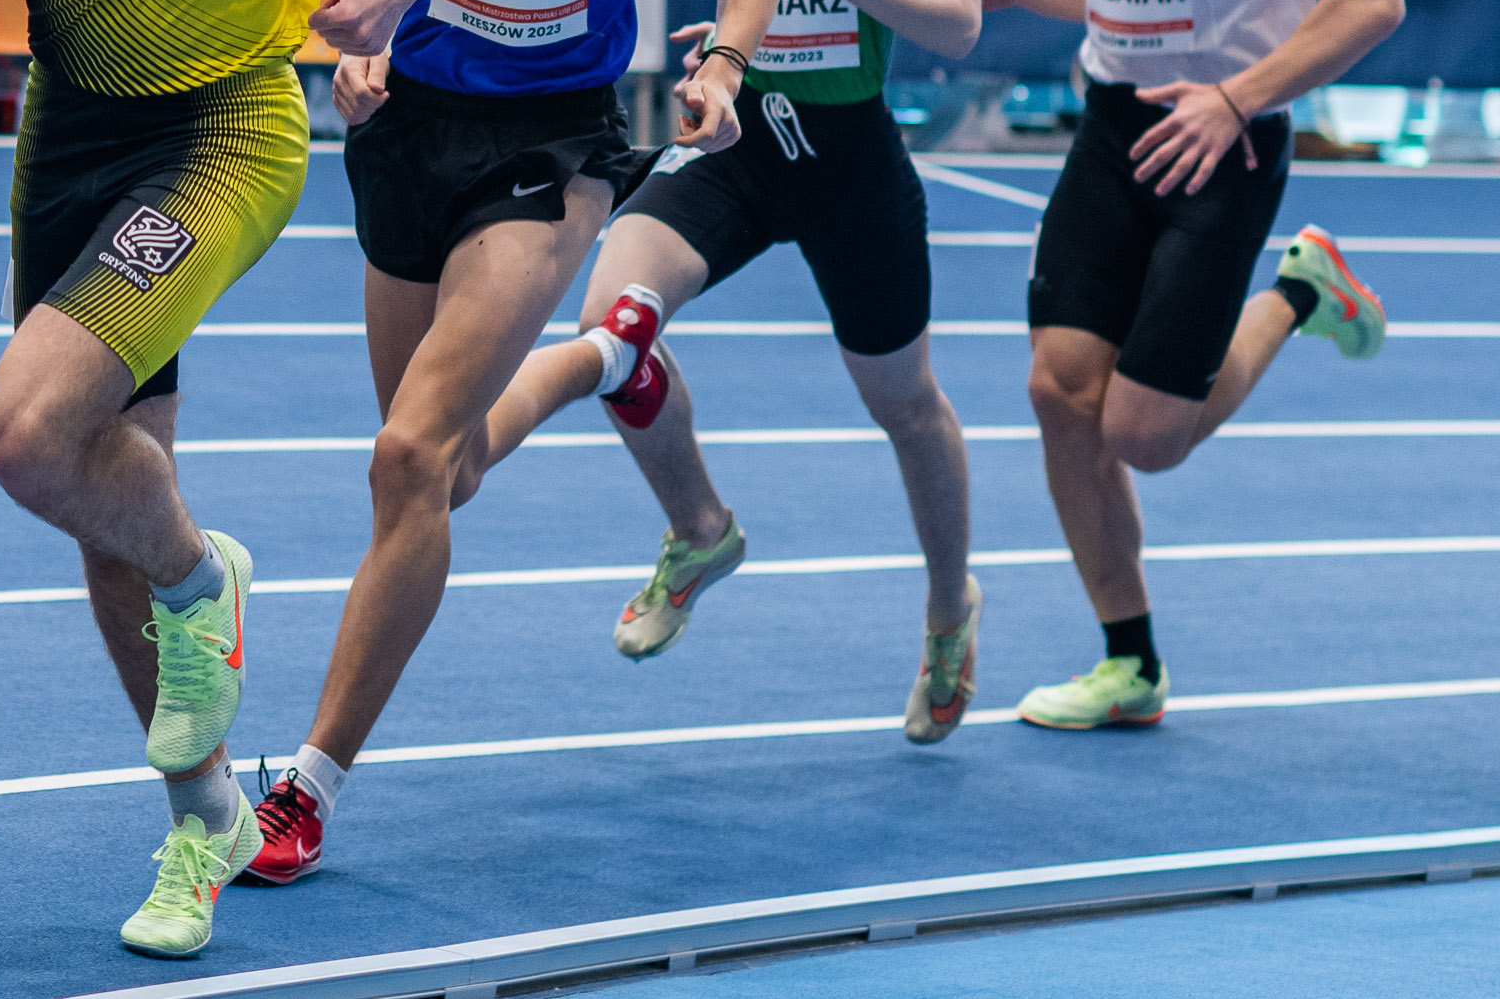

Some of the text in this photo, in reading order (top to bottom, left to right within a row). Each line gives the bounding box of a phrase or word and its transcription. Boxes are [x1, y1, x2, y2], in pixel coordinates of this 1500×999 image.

[462, 12, 562, 38] RZESZÓW 2023
[789, 50, 823, 63] 2023
[98, 252, 150, 290] GRYFINO
